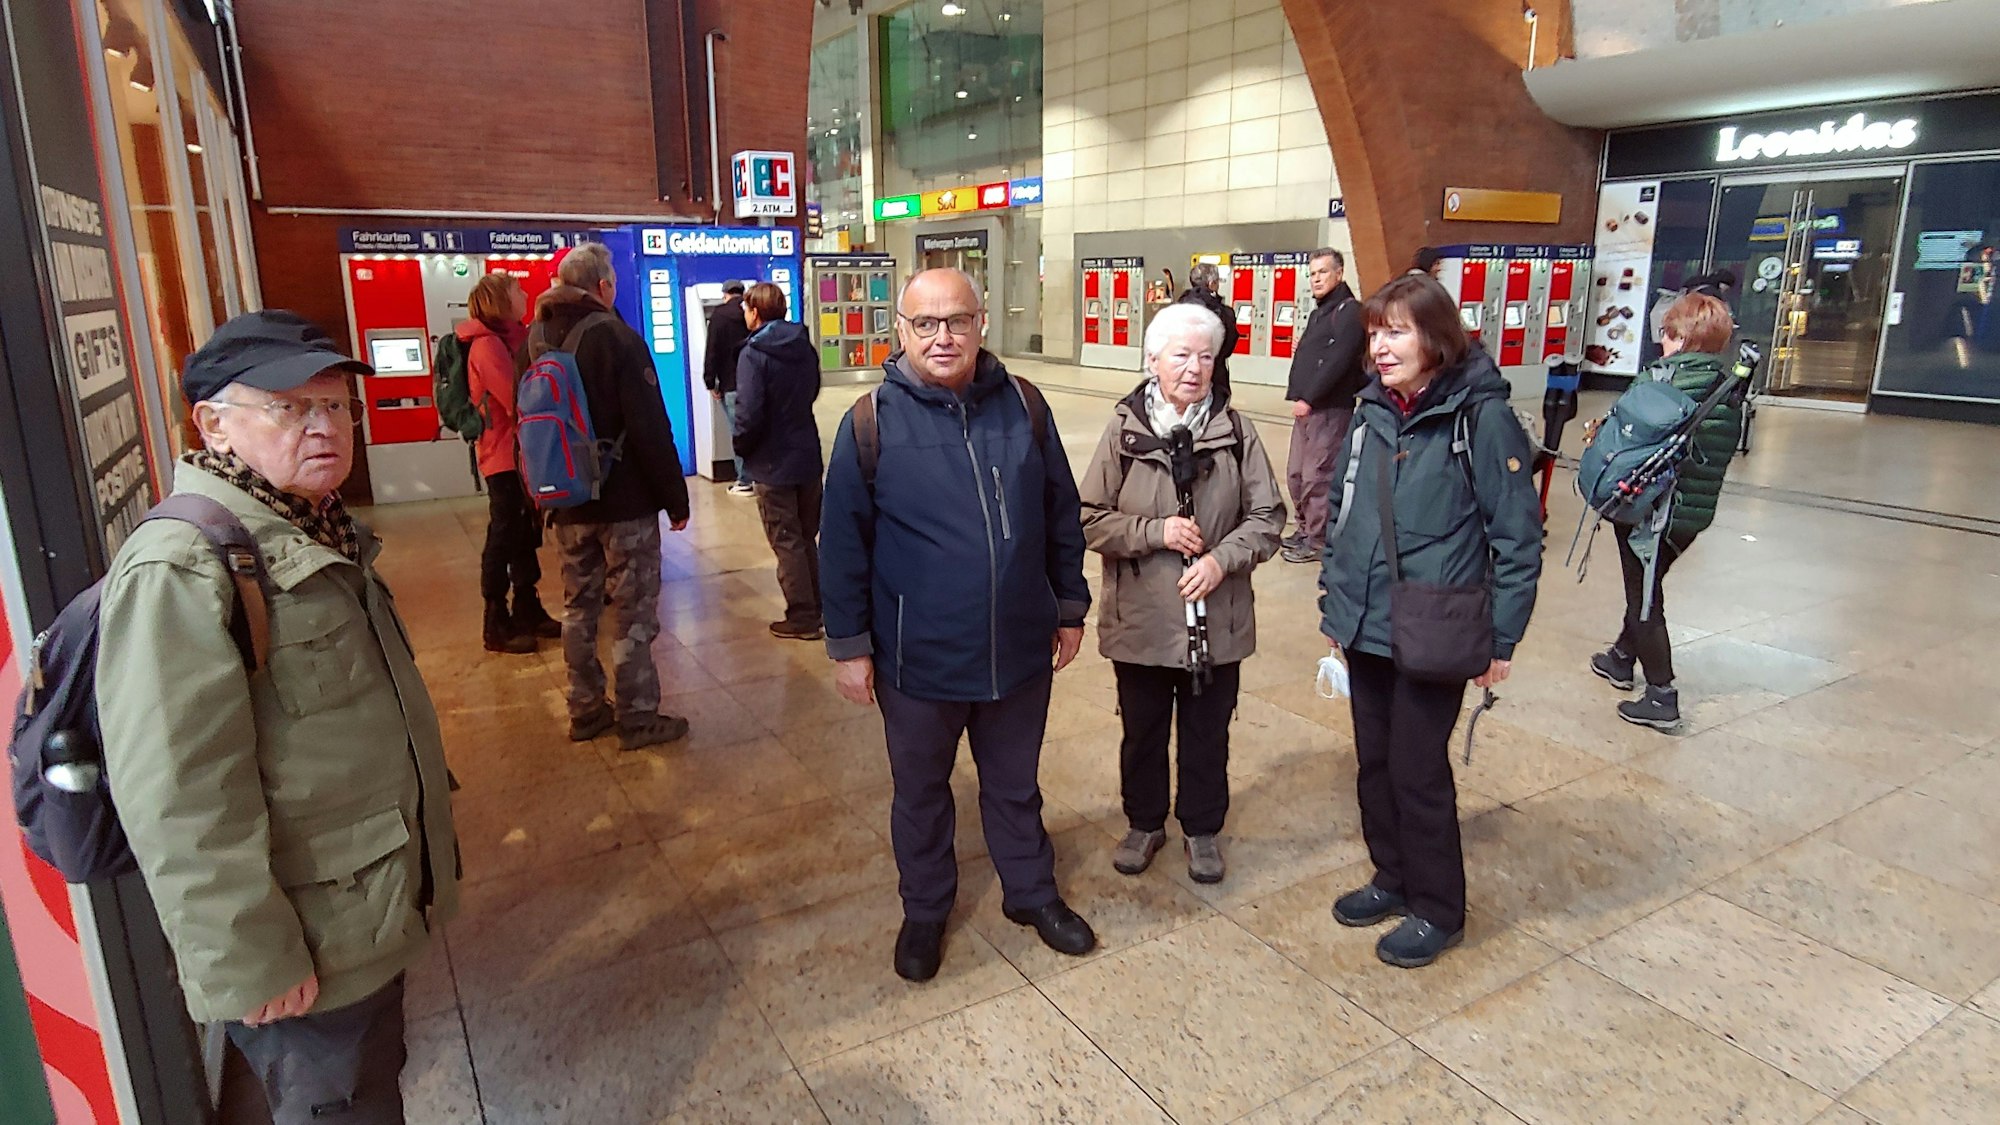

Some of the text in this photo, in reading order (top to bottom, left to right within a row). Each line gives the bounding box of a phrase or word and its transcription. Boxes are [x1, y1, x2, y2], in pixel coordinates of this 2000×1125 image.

[1716, 113, 1917, 161] Leonidas
[763, 204, 780, 213] ATM
[353, 231, 411, 242] Fahrkarten
[489, 232, 542, 243] Fahrkarten
[669, 232, 770, 253] Geldautomat
[74, 324, 121, 380] GIFTS
